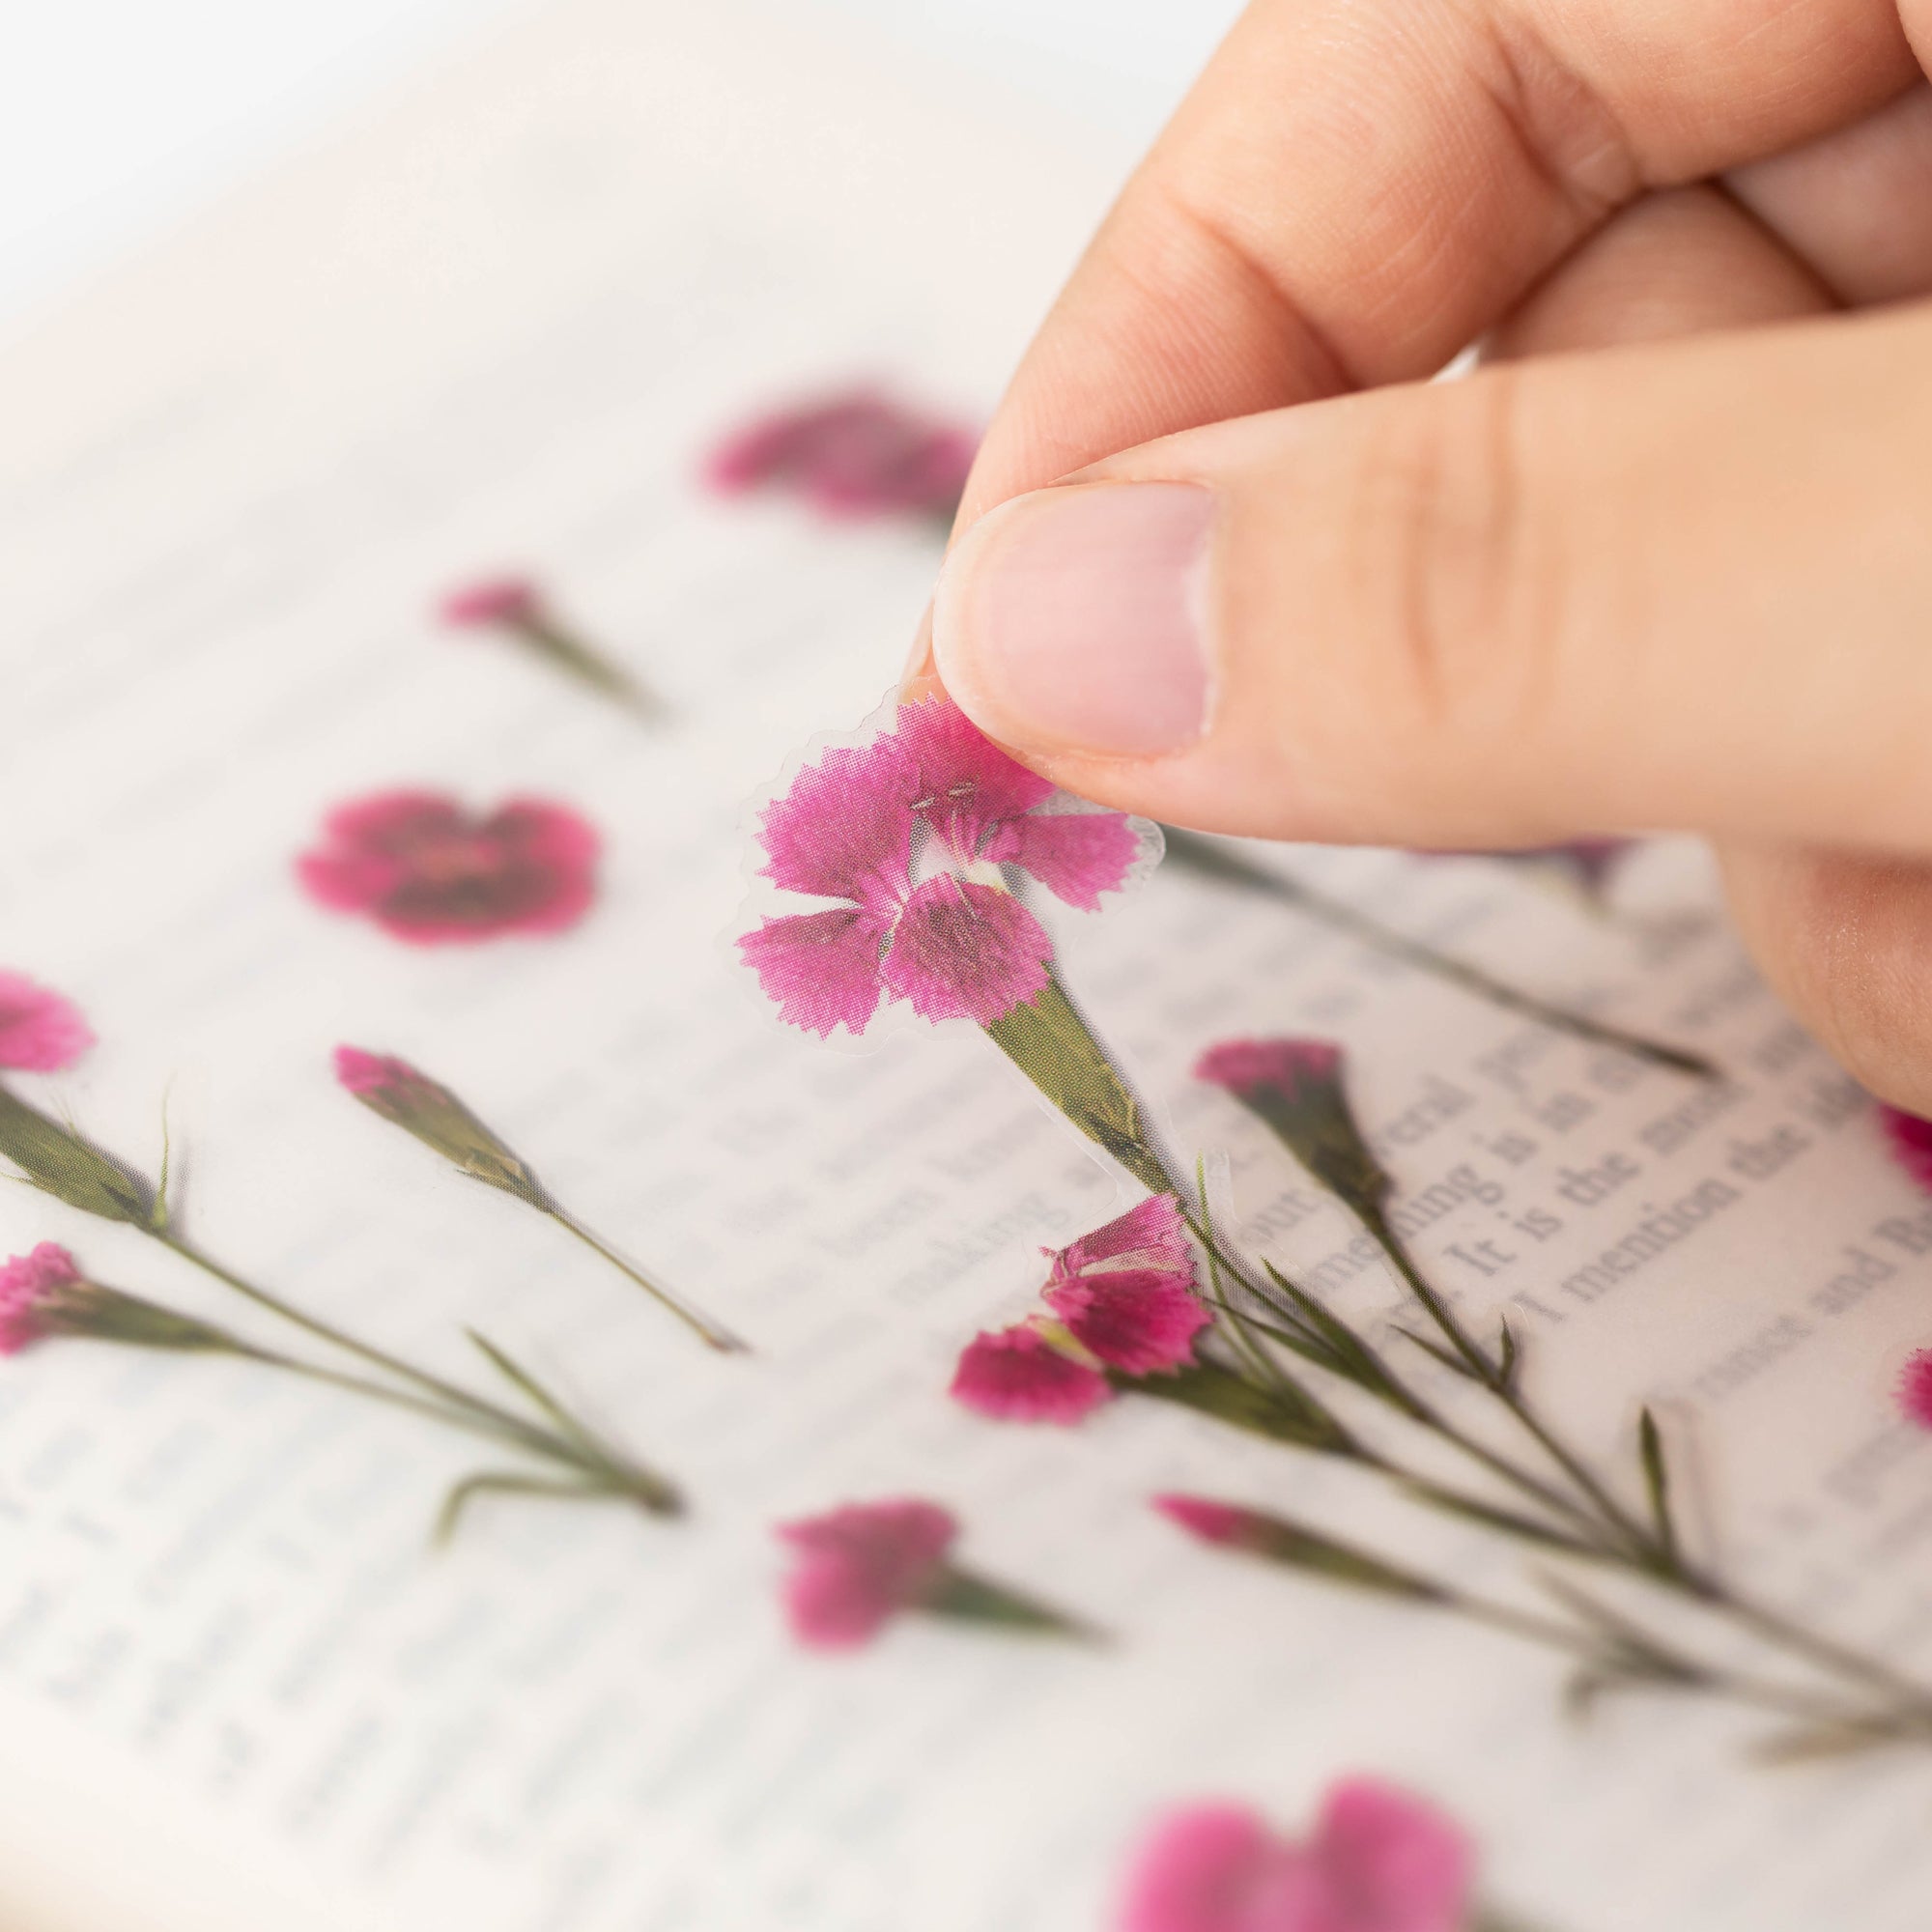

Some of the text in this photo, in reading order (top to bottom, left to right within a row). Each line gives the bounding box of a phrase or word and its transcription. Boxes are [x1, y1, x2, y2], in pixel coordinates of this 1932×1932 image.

[1442, 1238, 1519, 1278] It
[1494, 1205, 1565, 1243] is
[1553, 1153, 1642, 1208] the
[1559, 1175, 1743, 1303] mention
[1806, 1244, 1900, 1317] and
